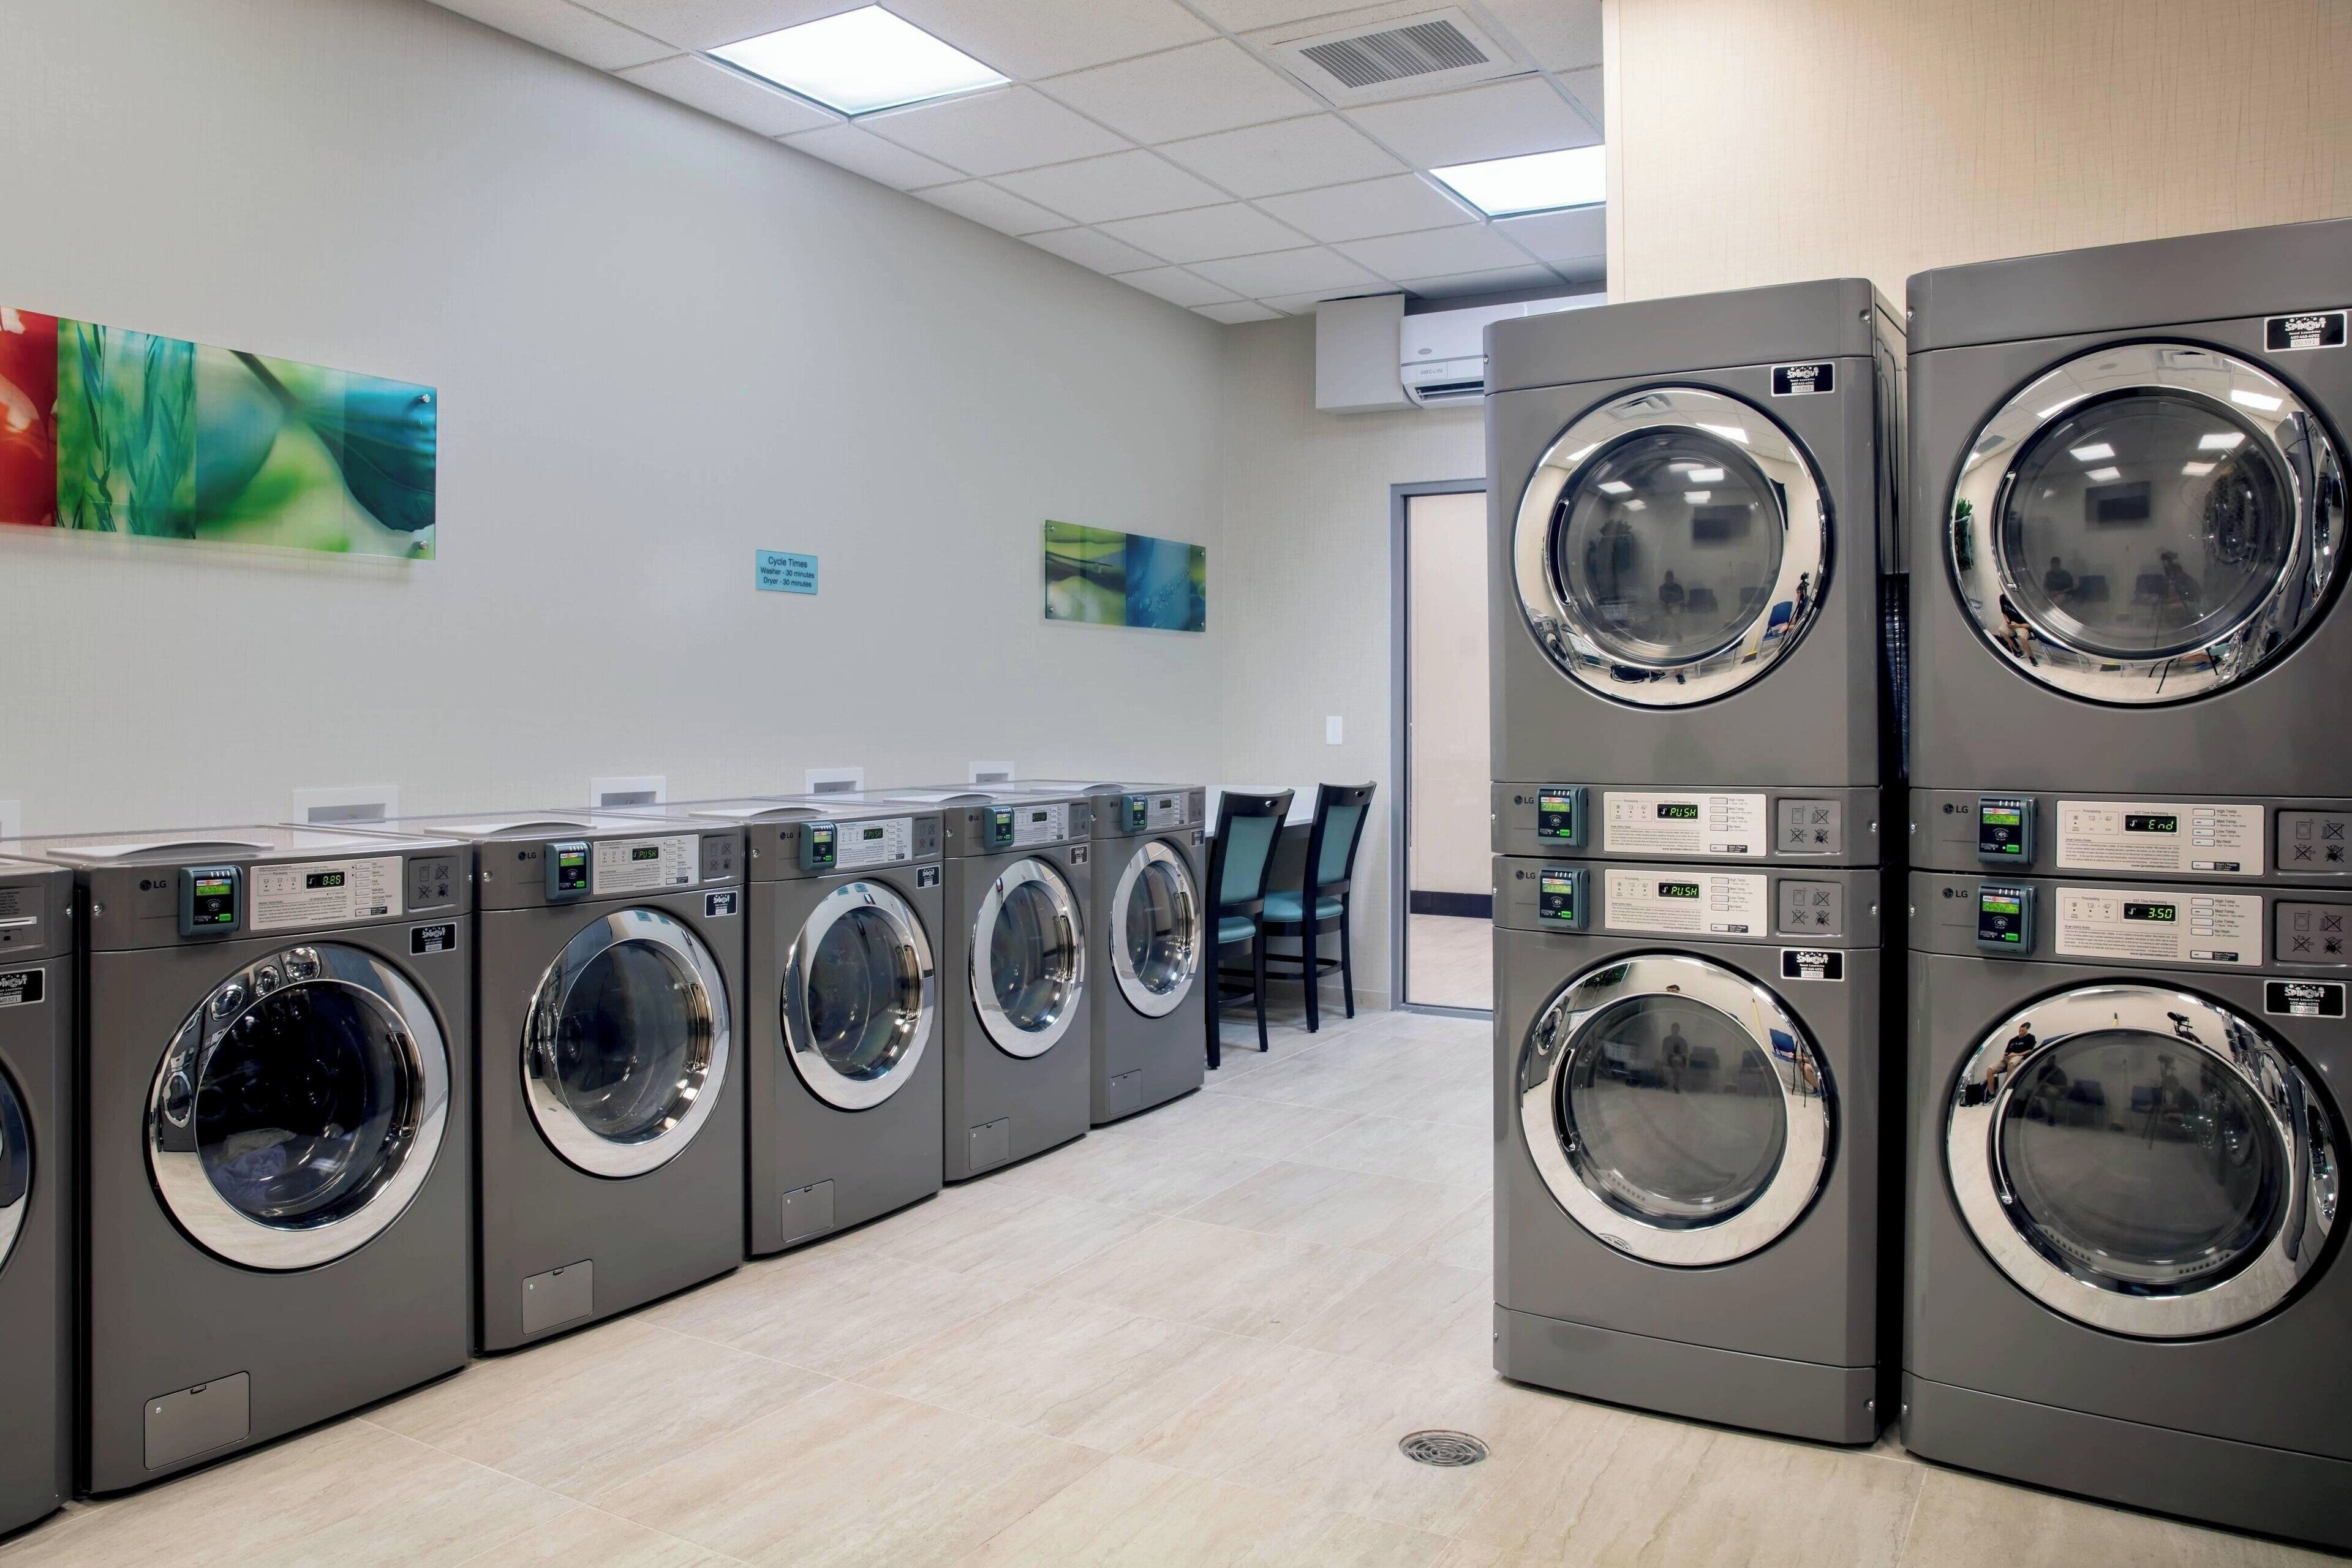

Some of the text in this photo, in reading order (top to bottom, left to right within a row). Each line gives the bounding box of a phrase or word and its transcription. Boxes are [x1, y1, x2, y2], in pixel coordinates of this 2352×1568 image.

[768, 556, 807, 568] Cycle Times
[1670, 808, 1696, 817] PUSH
[2149, 820, 2174, 830] End
[154, 880, 167, 889] LG
[1671, 886, 1697, 896] PUSH
[2148, 908, 2173, 919] 3.50
